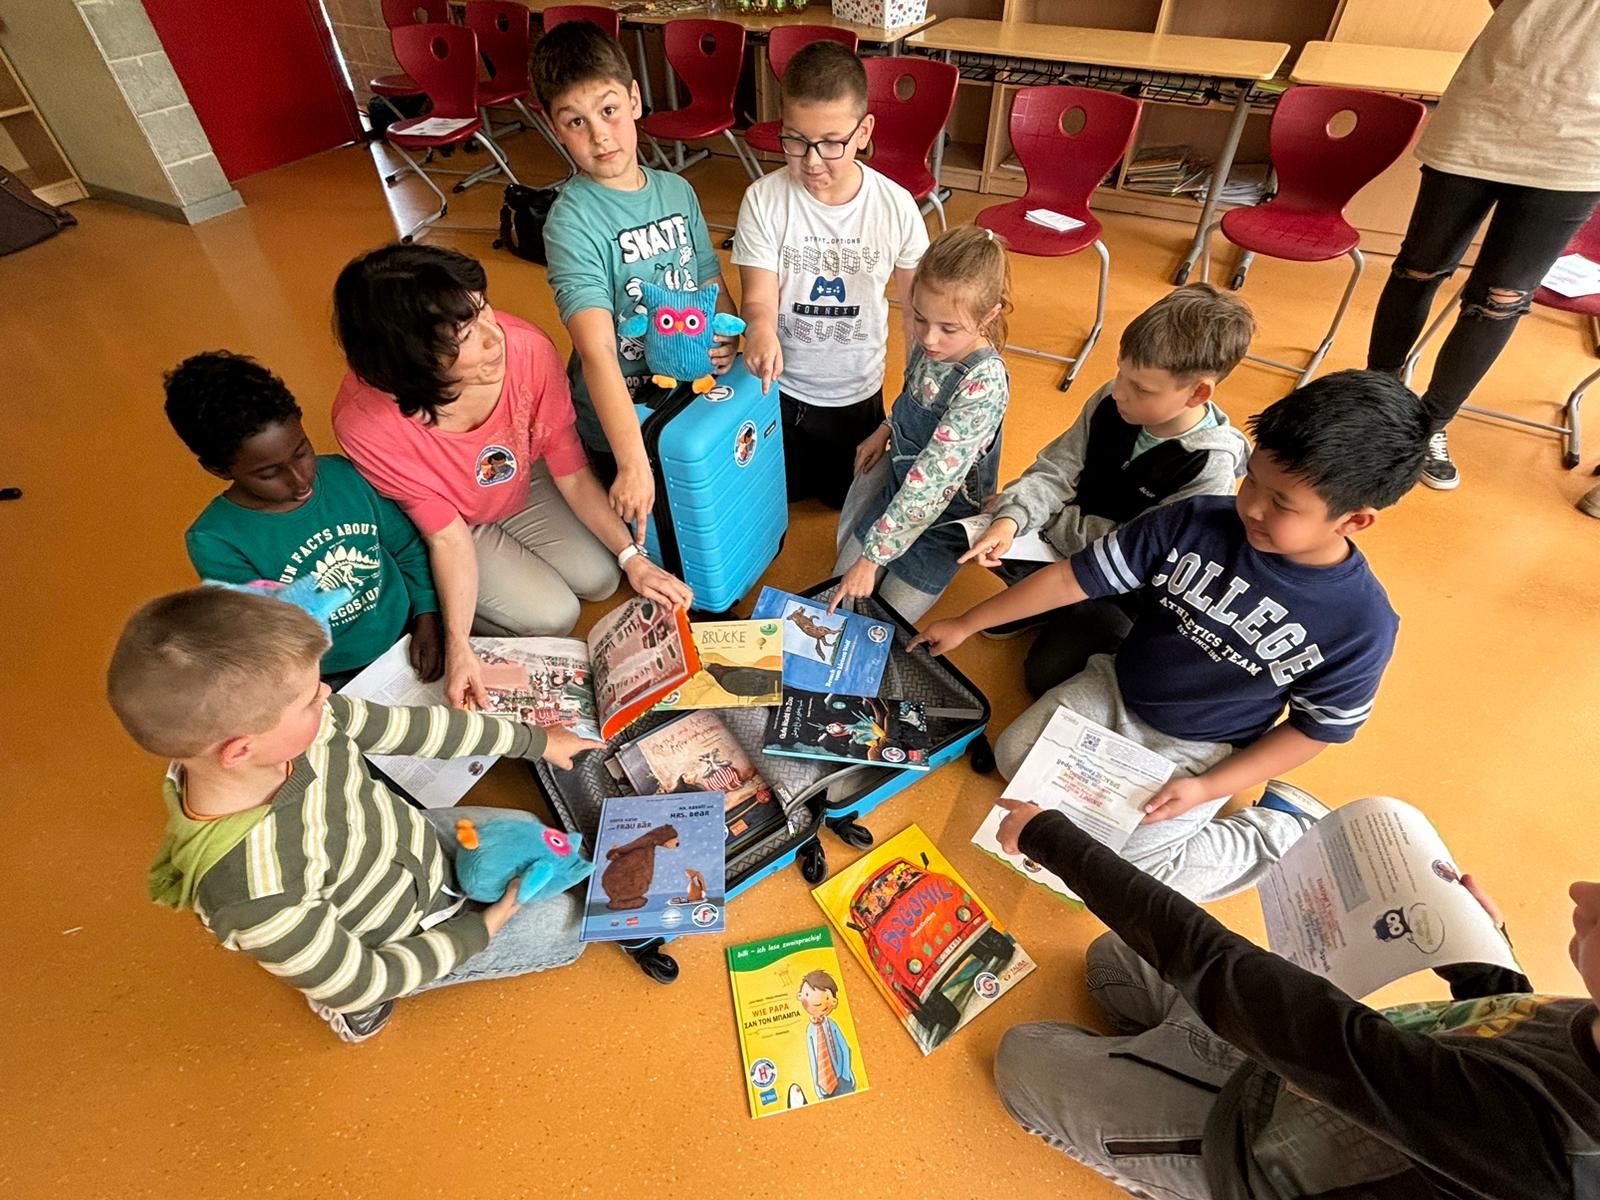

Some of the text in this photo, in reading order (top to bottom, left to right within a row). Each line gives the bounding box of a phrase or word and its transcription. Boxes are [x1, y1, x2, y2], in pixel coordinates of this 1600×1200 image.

[617, 213, 688, 264] SKATE
[783, 245, 880, 276] READY
[796, 306, 858, 316] FOR NEXT
[778, 313, 868, 345] LEVEL
[280, 523, 378, 584] UN FACTS ABOUT
[1152, 547, 1325, 687] COLLEGE
[701, 629, 747, 644] BRÜCKE
[1160, 596, 1263, 677] ATHLETICS TEAM
[1190, 634, 1211, 652] SINCE
[785, 695, 793, 706] Zoo
[781, 712, 790, 726] Nacht
[778, 726, 787, 739] Gute
[1055, 757, 1072, 770] Spaß
[880, 880, 953, 952] BOGOMIL
[781, 933, 822, 948] zweisprachig!
[982, 979, 993, 991] G
[751, 1003, 789, 1017] WIE PAPA
[758, 1066, 768, 1081] H
